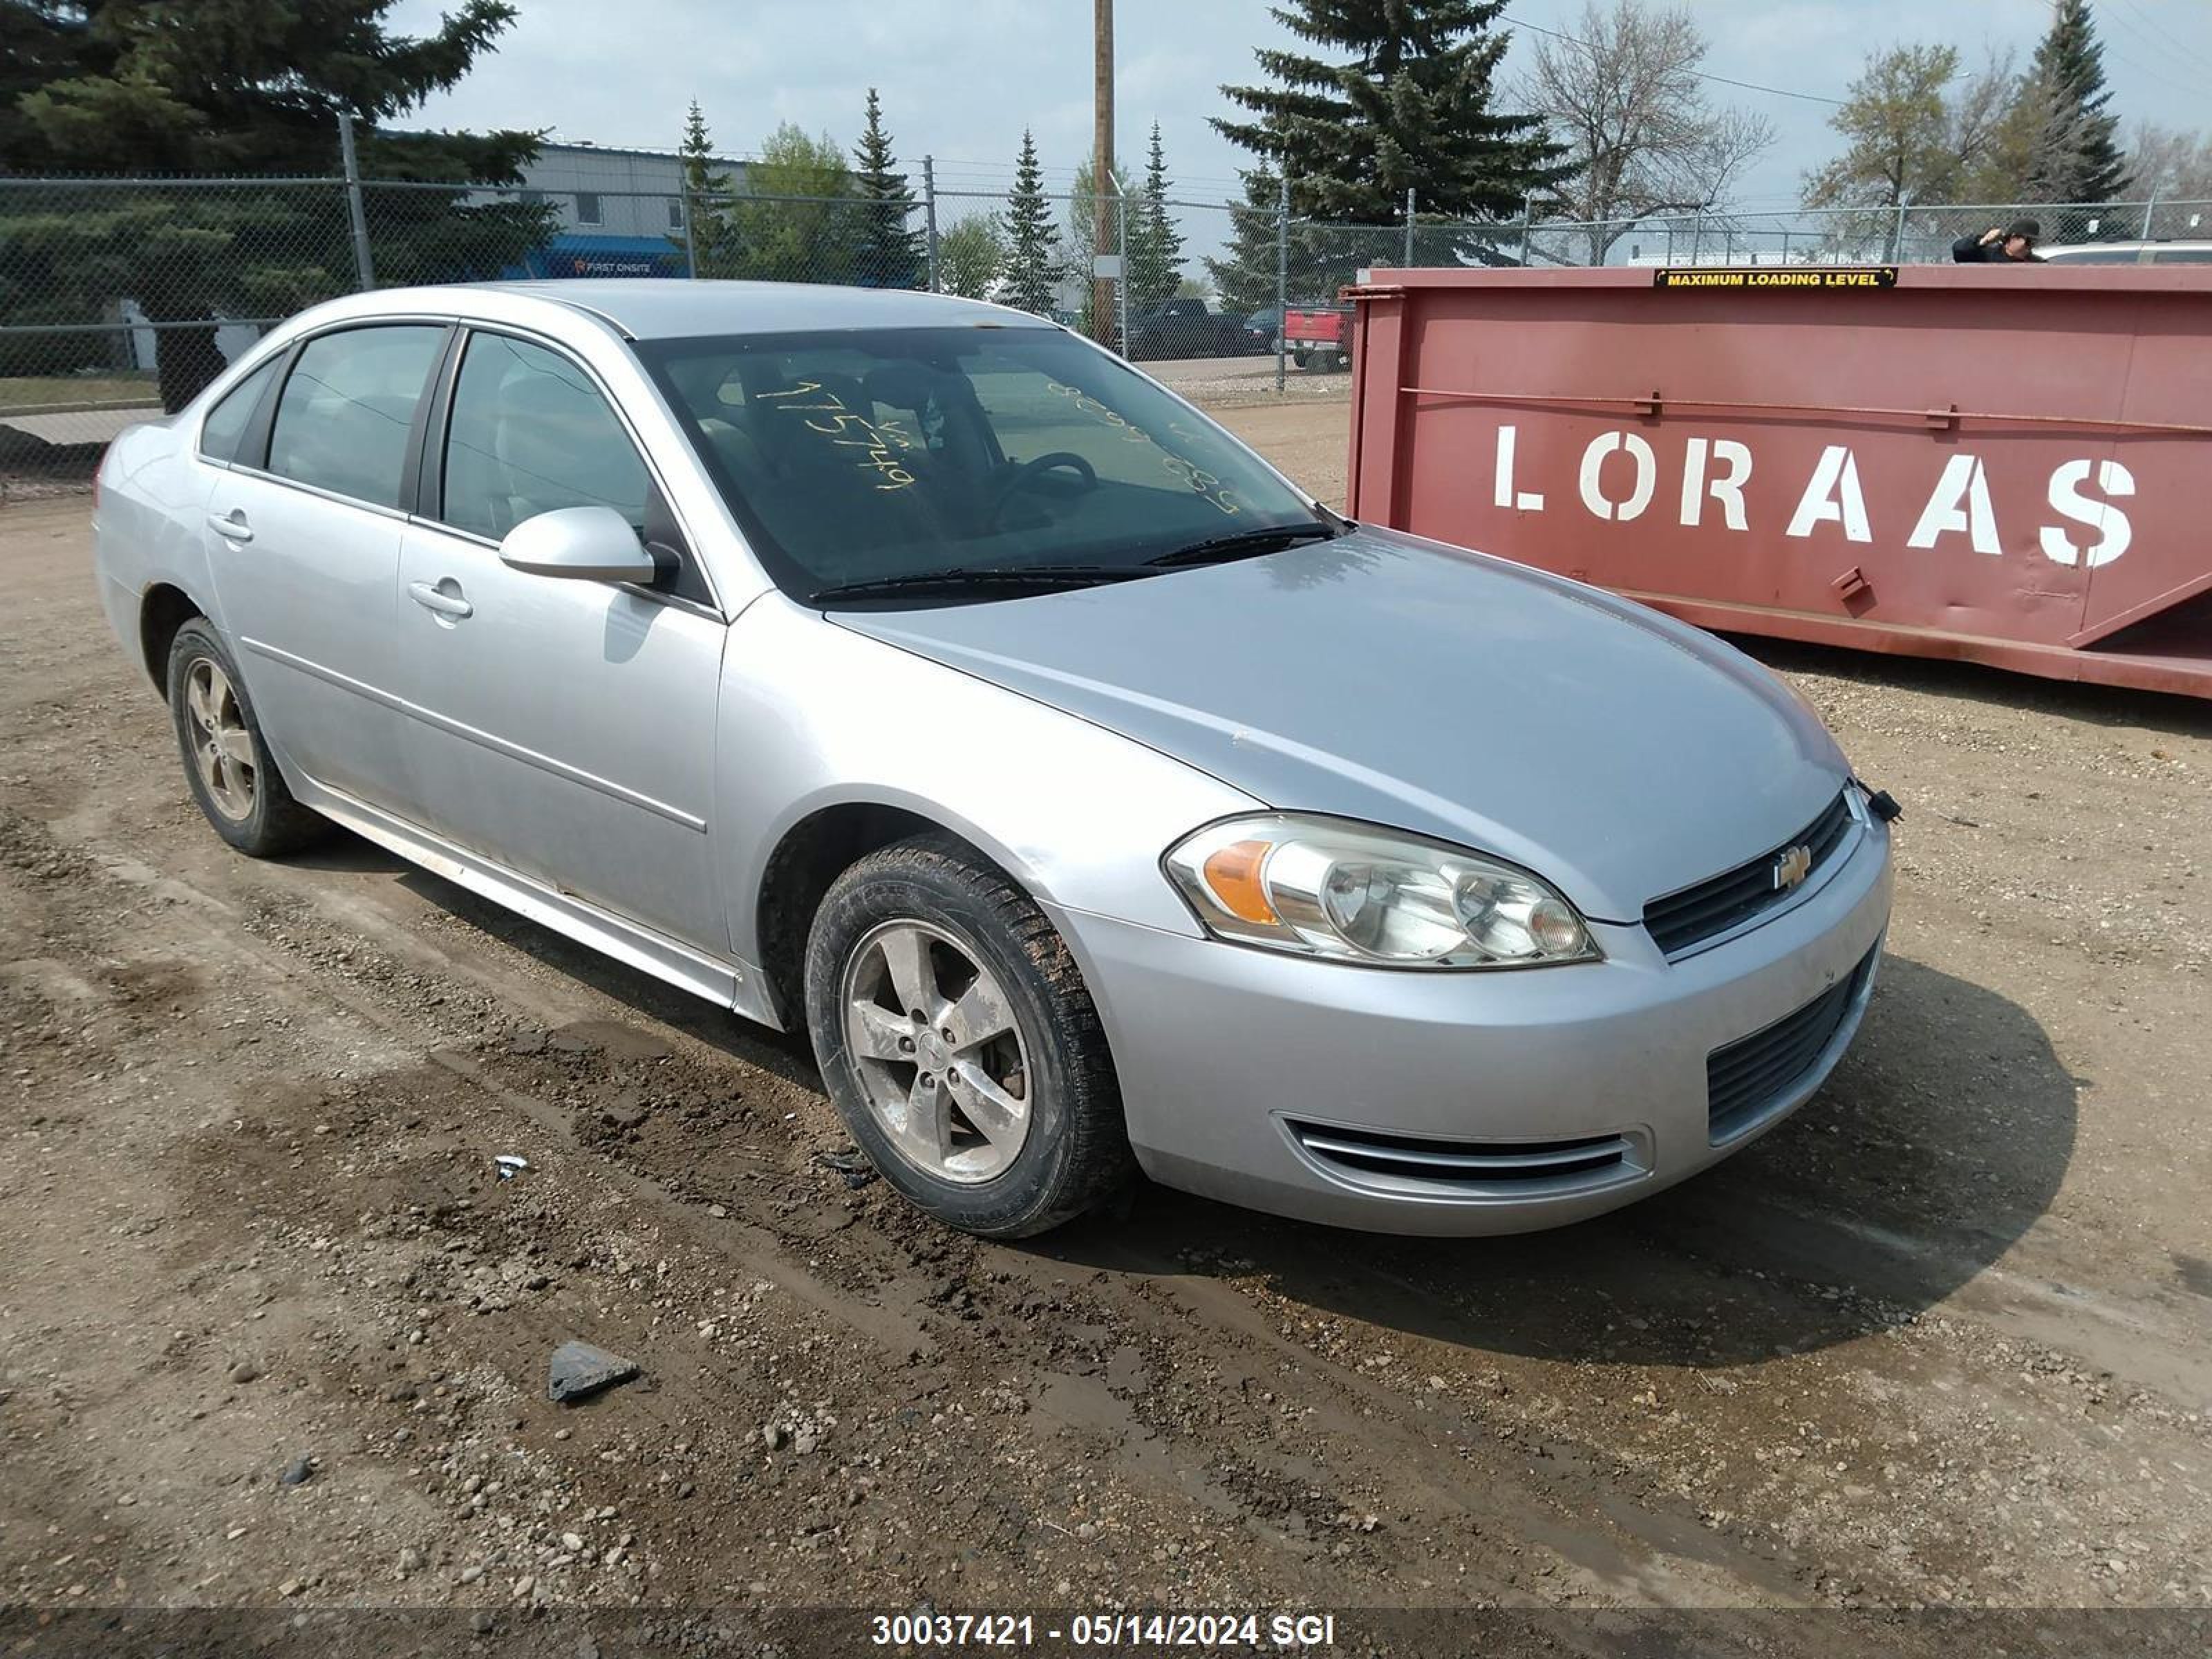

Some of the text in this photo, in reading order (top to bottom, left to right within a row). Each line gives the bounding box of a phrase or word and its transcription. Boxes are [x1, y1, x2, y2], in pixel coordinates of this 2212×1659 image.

[587, 263, 615, 272] FIRST
[1668, 274, 1880, 286] MAXIMUM LOADING LEVEL
[1494, 425, 2135, 568] LORAAS
